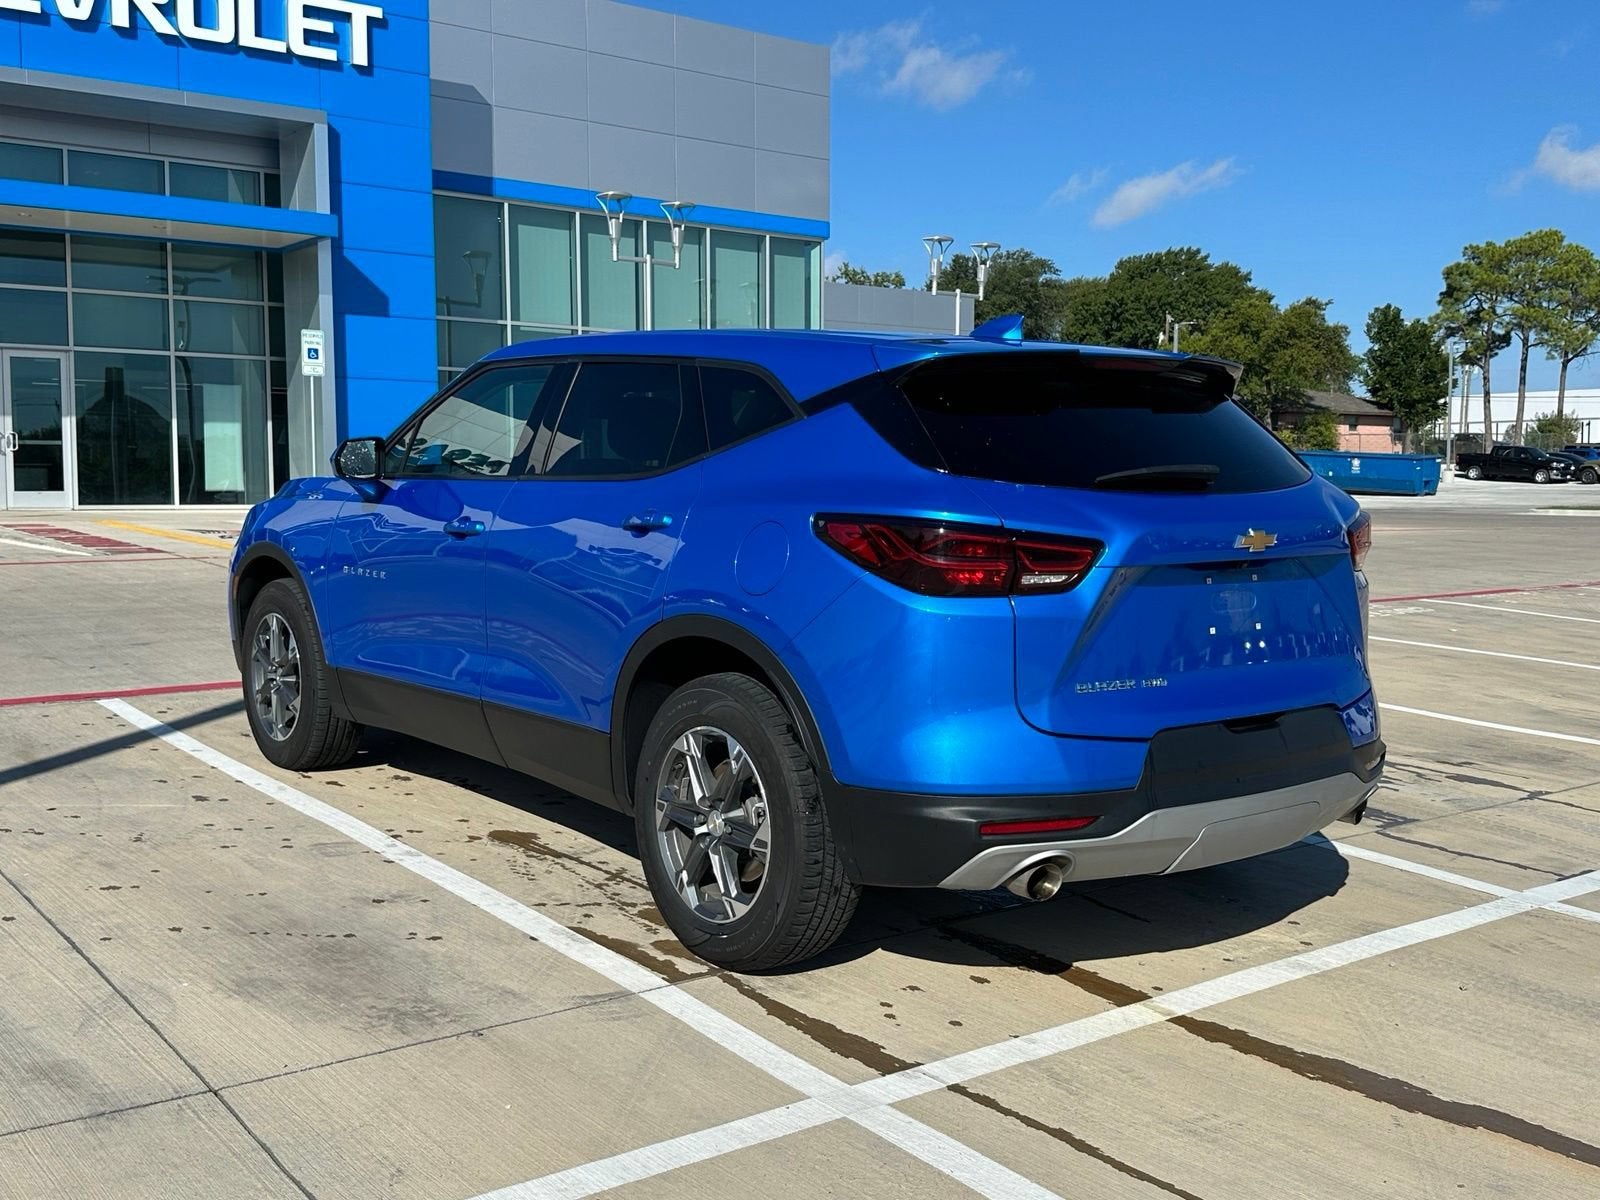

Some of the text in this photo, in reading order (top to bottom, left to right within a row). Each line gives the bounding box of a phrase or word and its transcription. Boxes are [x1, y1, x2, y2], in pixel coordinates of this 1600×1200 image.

[0, 0, 384, 67] ROLET
[342, 565, 387, 580] BLAZER
[1075, 679, 1137, 694] BLAZER
